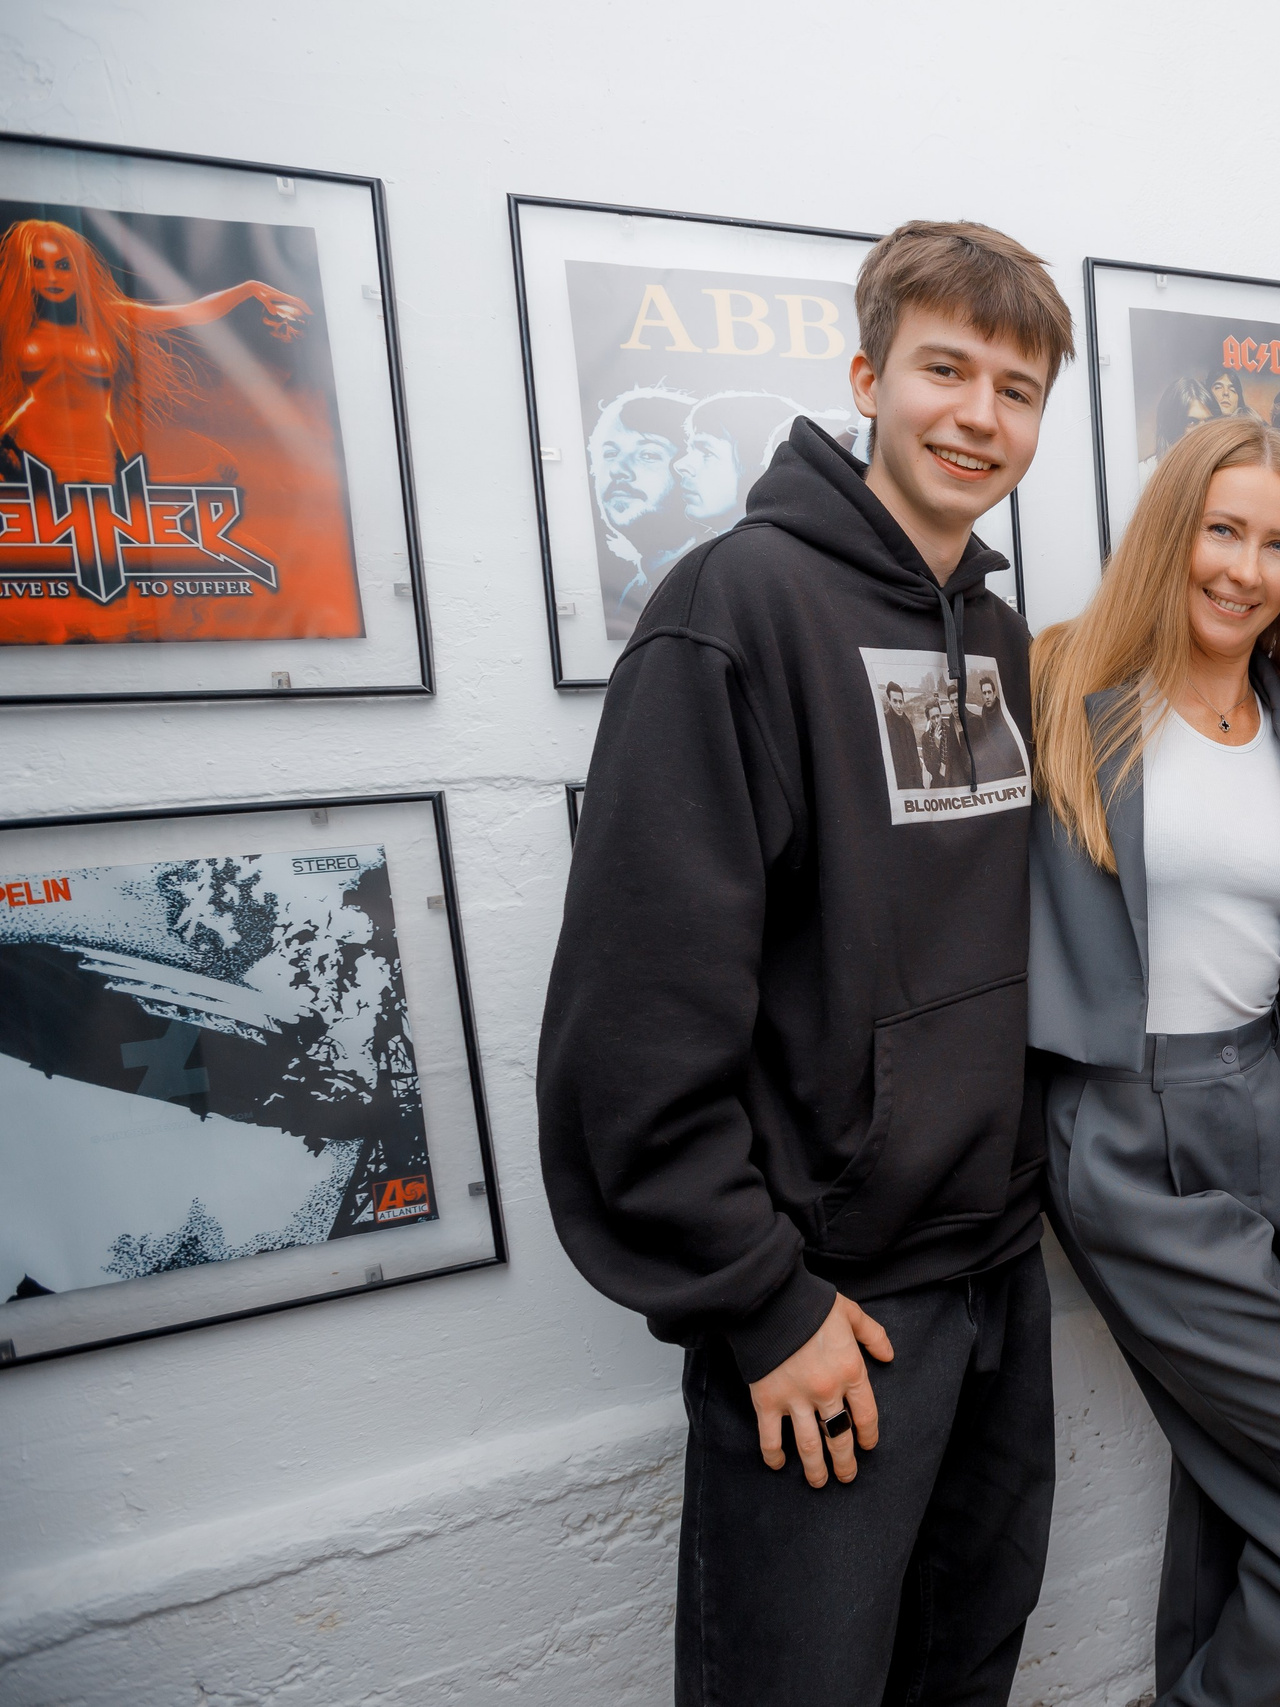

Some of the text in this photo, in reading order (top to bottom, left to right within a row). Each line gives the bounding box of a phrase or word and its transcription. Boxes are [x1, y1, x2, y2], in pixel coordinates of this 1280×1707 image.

[620, 284, 852, 362] ABB
[0, 580, 253, 597] IVE IS TO SUFFER
[903, 785, 1027, 814] BLOOMCENTURY
[292, 857, 359, 873] STEREO
[379, 1203, 428, 1220] ATLANTIC
